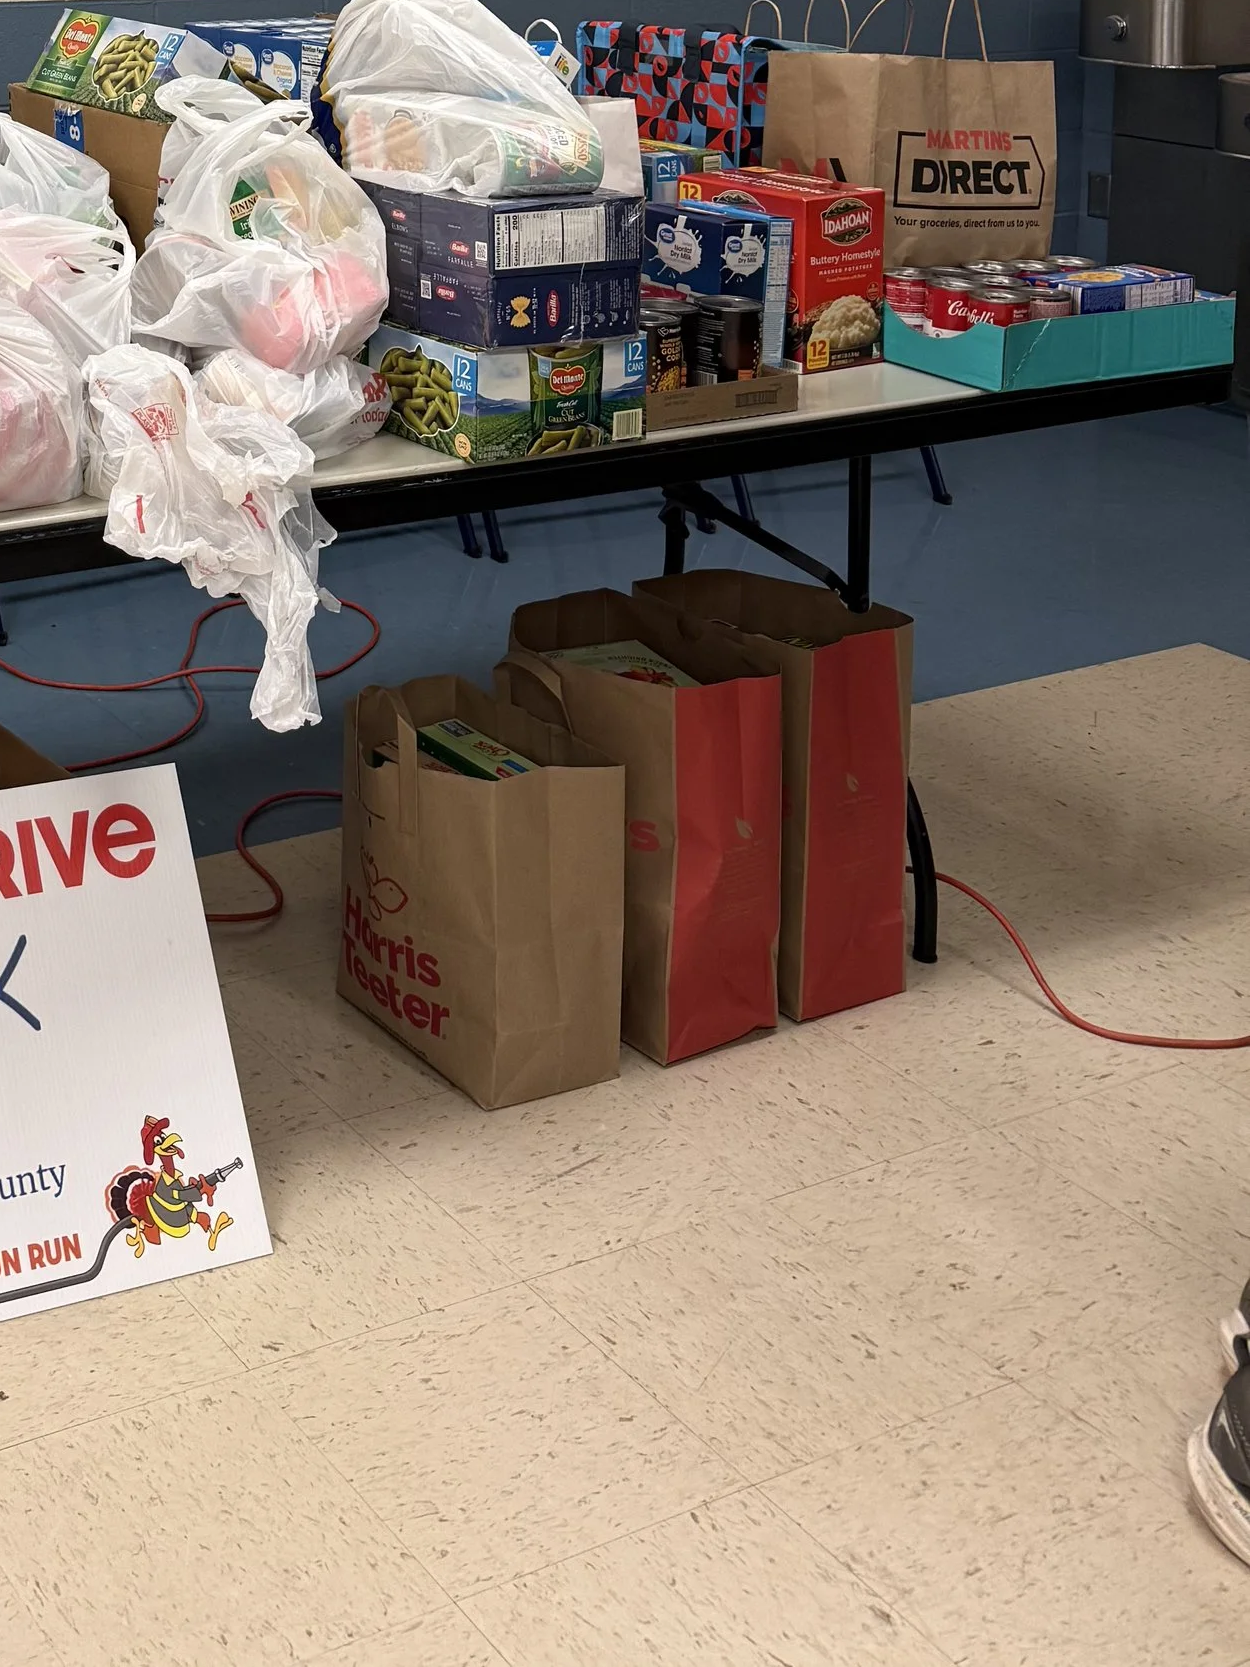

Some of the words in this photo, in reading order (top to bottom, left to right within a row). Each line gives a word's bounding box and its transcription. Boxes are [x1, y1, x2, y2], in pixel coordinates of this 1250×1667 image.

[167, 34, 180, 52] 12
[158, 49, 173, 61] CANS
[554, 55, 570, 76] life
[50, 69, 64, 80] GREEN
[64, 73, 78, 83] BEANS
[926, 128, 1012, 152] MARTINS
[657, 161, 671, 179] 12
[911, 158, 1031, 195] DIRECT
[681, 184, 700, 200] 12
[824, 210, 870, 235] IDAHOAN
[894, 216, 918, 227] Your
[920, 217, 962, 230] groceries,
[963, 218, 986, 228] direct
[987, 218, 1005, 228] from
[1006, 220, 1015, 228] us
[1016, 219, 1024, 228] to
[1025, 220, 1040, 230] you.
[670, 251, 680, 260] Dry
[680, 252, 692, 261] Milk
[738, 257, 747, 265] Dry
[810, 254, 841, 266] Buttery
[841, 247, 881, 262] Homestyle
[844, 263, 873, 272] POTATOES
[549, 293, 558, 323] Barilla
[627, 341, 643, 361] 12
[810, 339, 828, 358] 12
[456, 356, 472, 380] 12
[627, 361, 645, 372] CANS
[455, 378, 473, 393] CANS
[552, 373, 563, 385] Del
[563, 372, 585, 385] Monte
[548, 413, 567, 424] GREEN
[567, 411, 586, 423] BEANS
[561, 407, 575, 417] CUT
[345, 885, 442, 988] Harris
[342, 929, 450, 1038] Teeter
[27, 1232, 83, 1273] RUN
